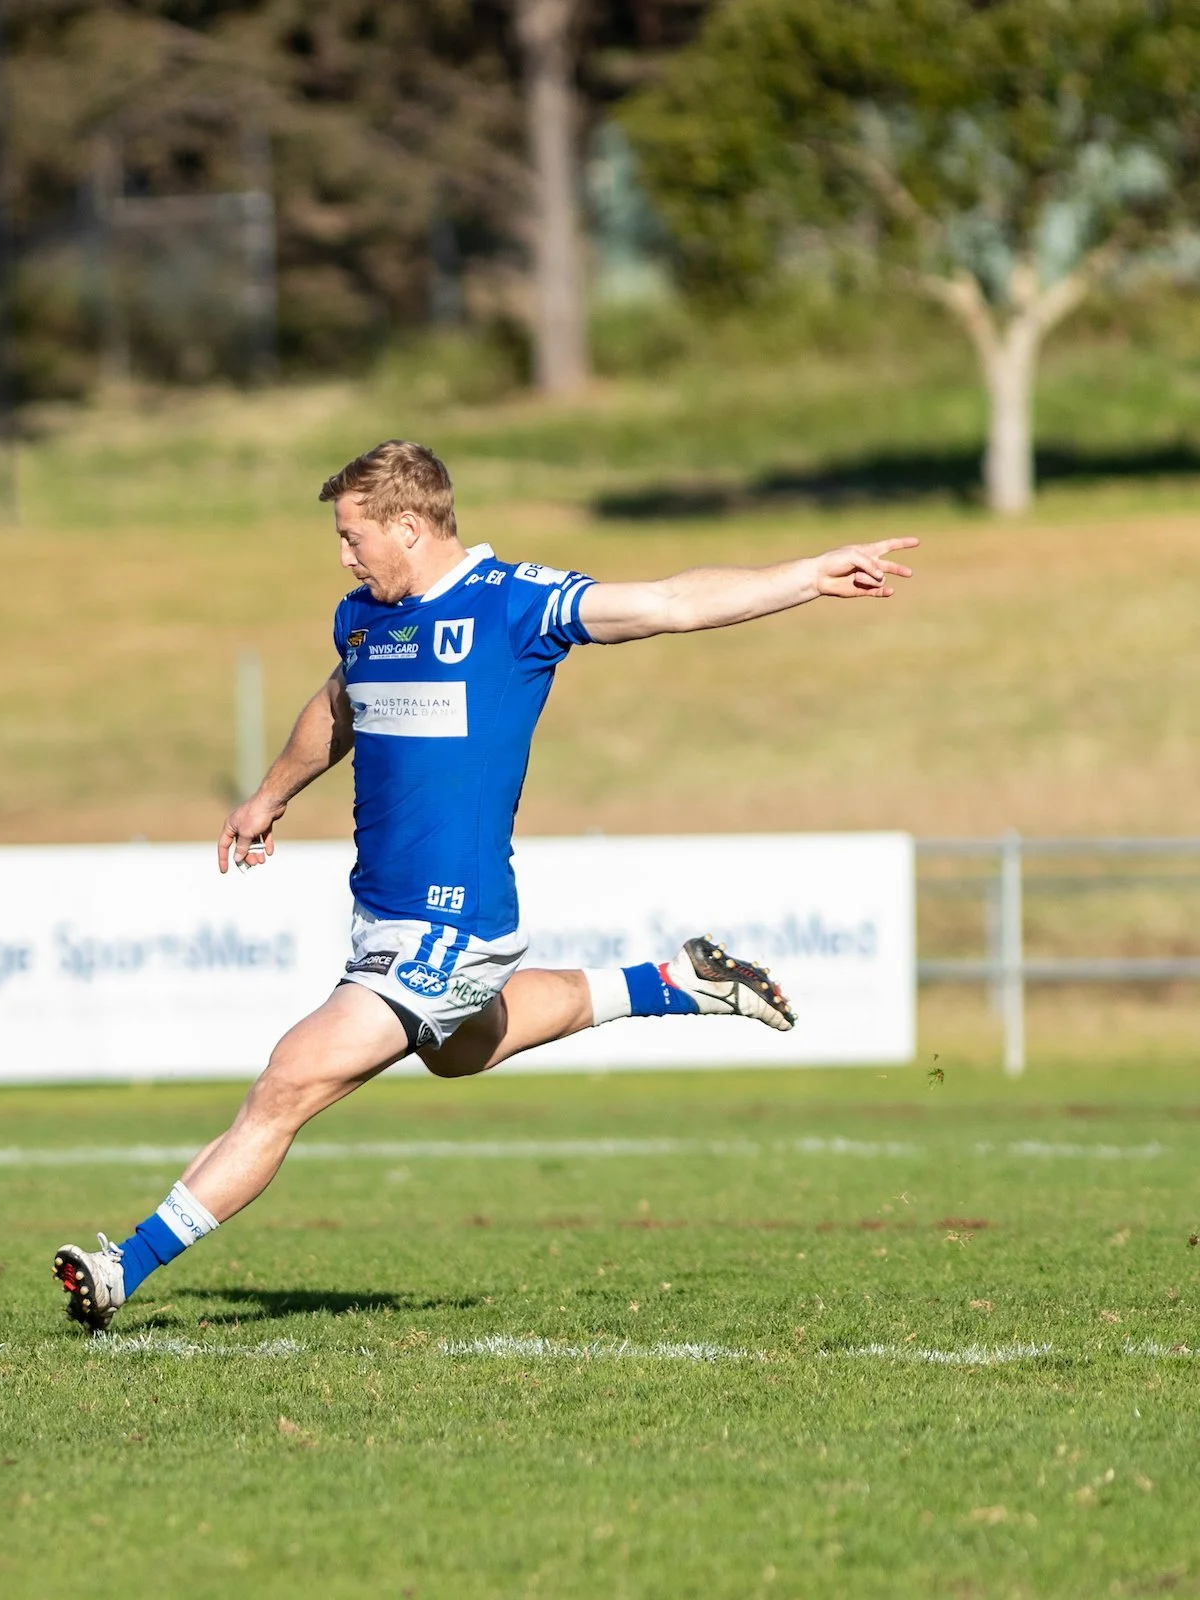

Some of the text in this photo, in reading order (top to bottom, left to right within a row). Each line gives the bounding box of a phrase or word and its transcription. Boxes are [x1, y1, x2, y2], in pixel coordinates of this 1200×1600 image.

[440, 625, 464, 654] N
[368, 643, 419, 654] INVISI-GARD
[374, 698, 451, 707] AUSTRALIAN
[373, 707, 418, 716] MUTUAL
[427, 885, 465, 909] GFS
[56, 922, 296, 981] SportsMed
